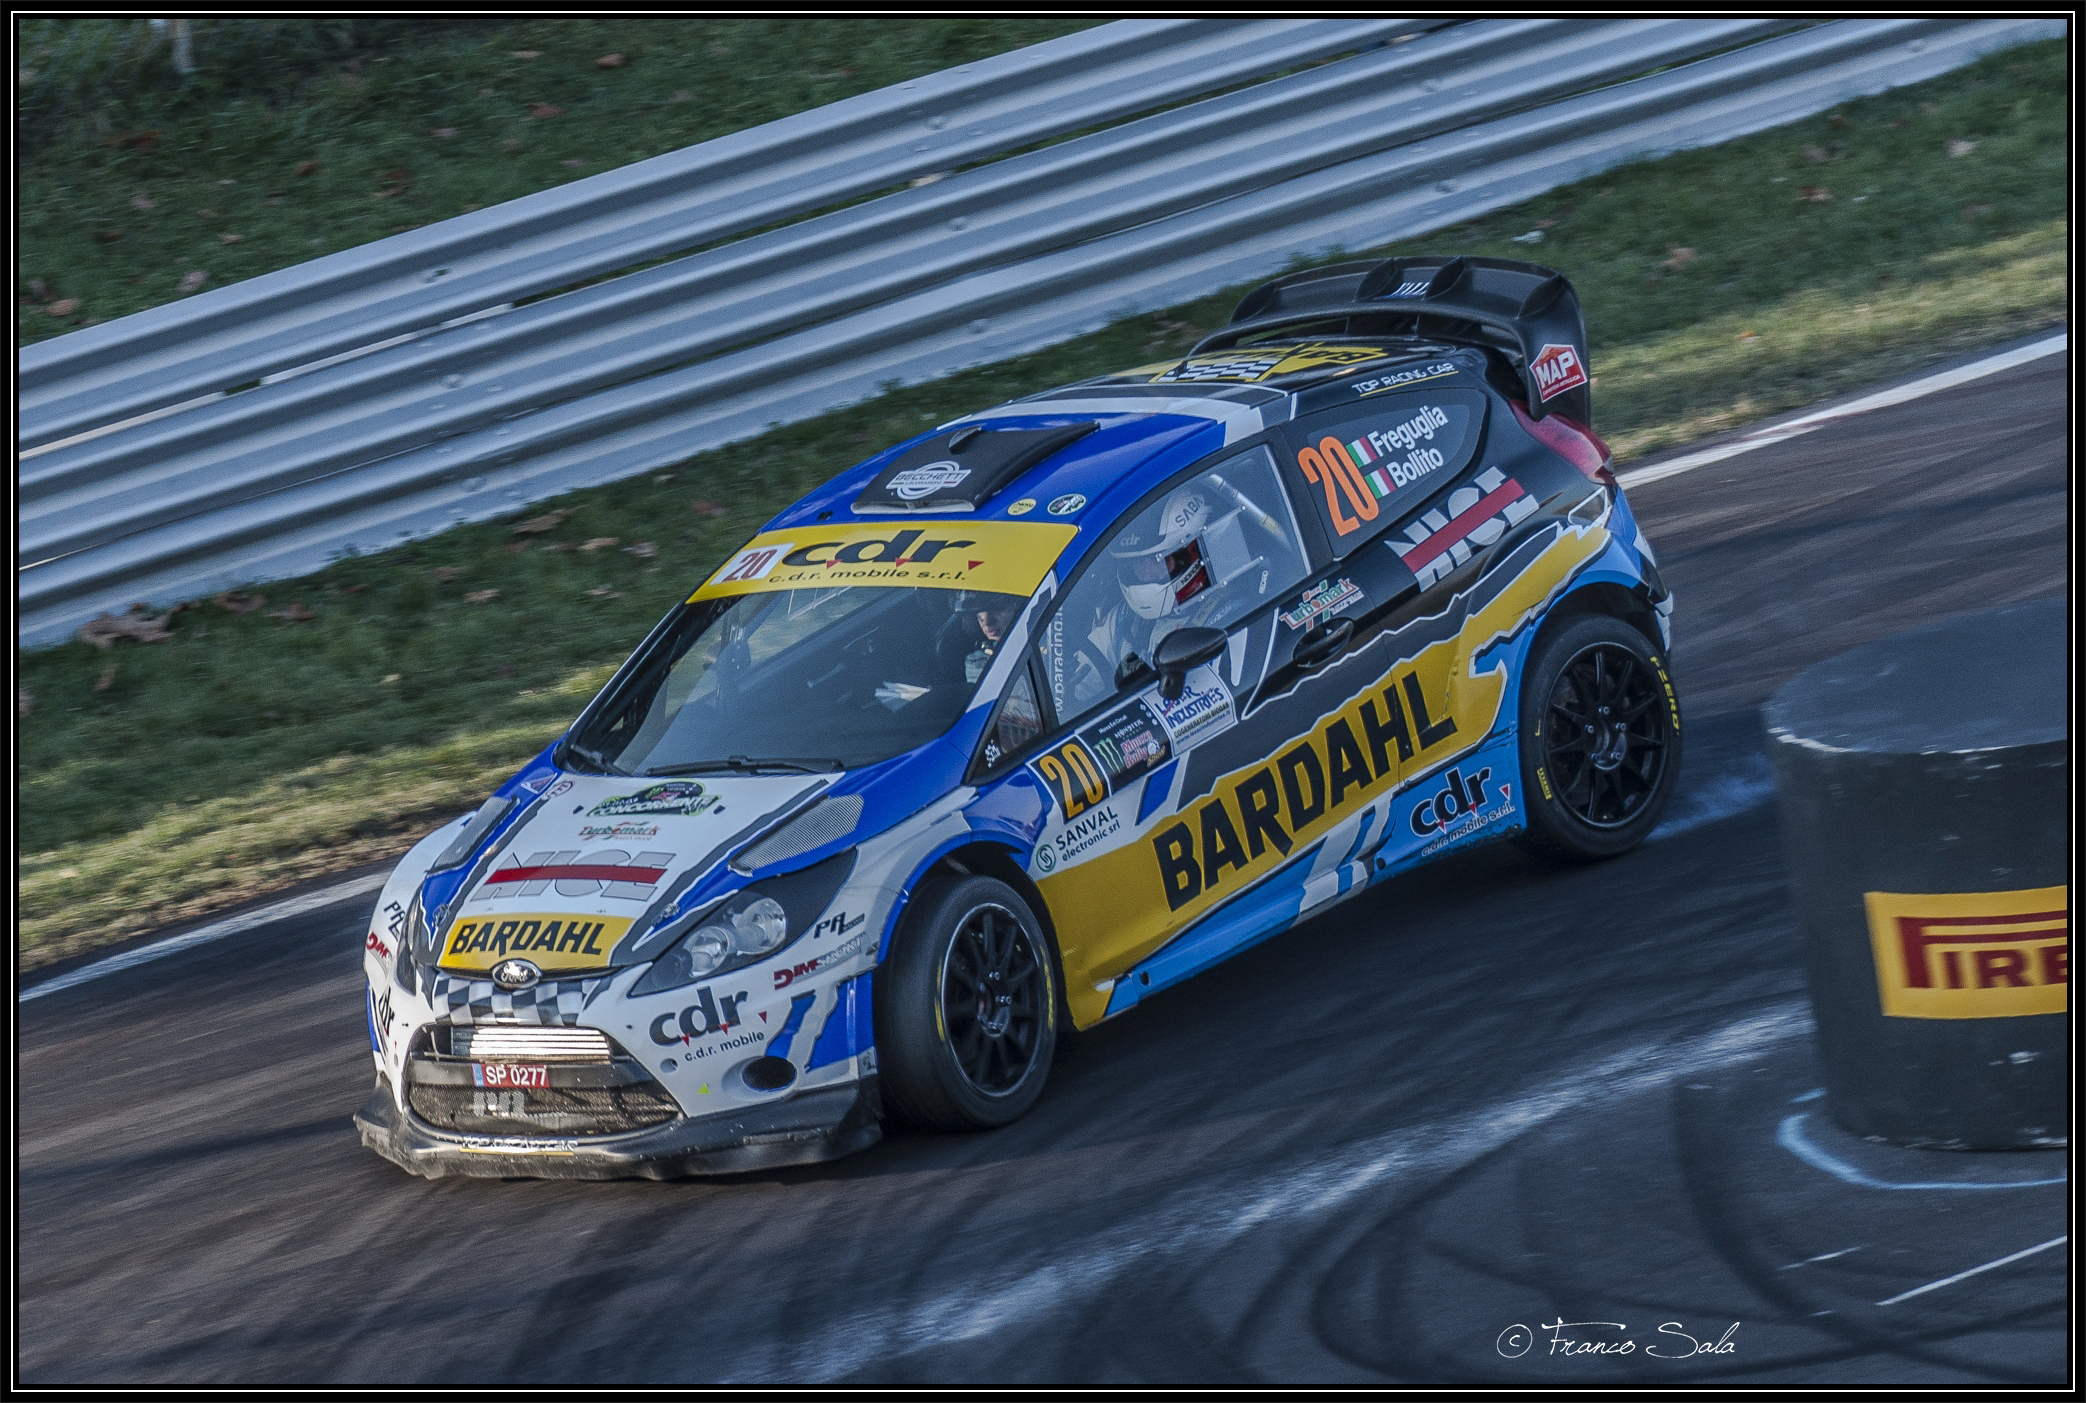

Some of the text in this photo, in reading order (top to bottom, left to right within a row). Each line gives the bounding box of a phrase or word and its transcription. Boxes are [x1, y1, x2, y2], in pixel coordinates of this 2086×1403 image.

[1351, 362, 1455, 393] TOP RACING CAR
[1535, 350, 1575, 389] MAP
[1367, 404, 1449, 458] Freguglia
[895, 472, 967, 481] BECCHETTI
[1297, 435, 1380, 537] 20
[1386, 447, 1444, 488] Bollito
[781, 529, 977, 567] cdr
[1383, 465, 1540, 593] NICE
[721, 549, 778, 583] 20
[768, 567, 966, 583] c.d.r. mobile s.r.l.
[1165, 687, 1225, 730] INDUSTRIES
[1039, 743, 1104, 819] 20
[1152, 670, 1458, 913] BARDAHL
[1409, 766, 1492, 838] cdr
[1055, 805, 1118, 851] SANVAL
[1061, 819, 1121, 862] electronic srl
[1449, 815, 1489, 842] mobile
[469, 848, 677, 902] NICE
[448, 920, 605, 958] BARDAHL
[648, 985, 749, 1047] cdr
[684, 1031, 765, 1062] c.d.r. mobile
[485, 1065, 547, 1087] SP 0277
